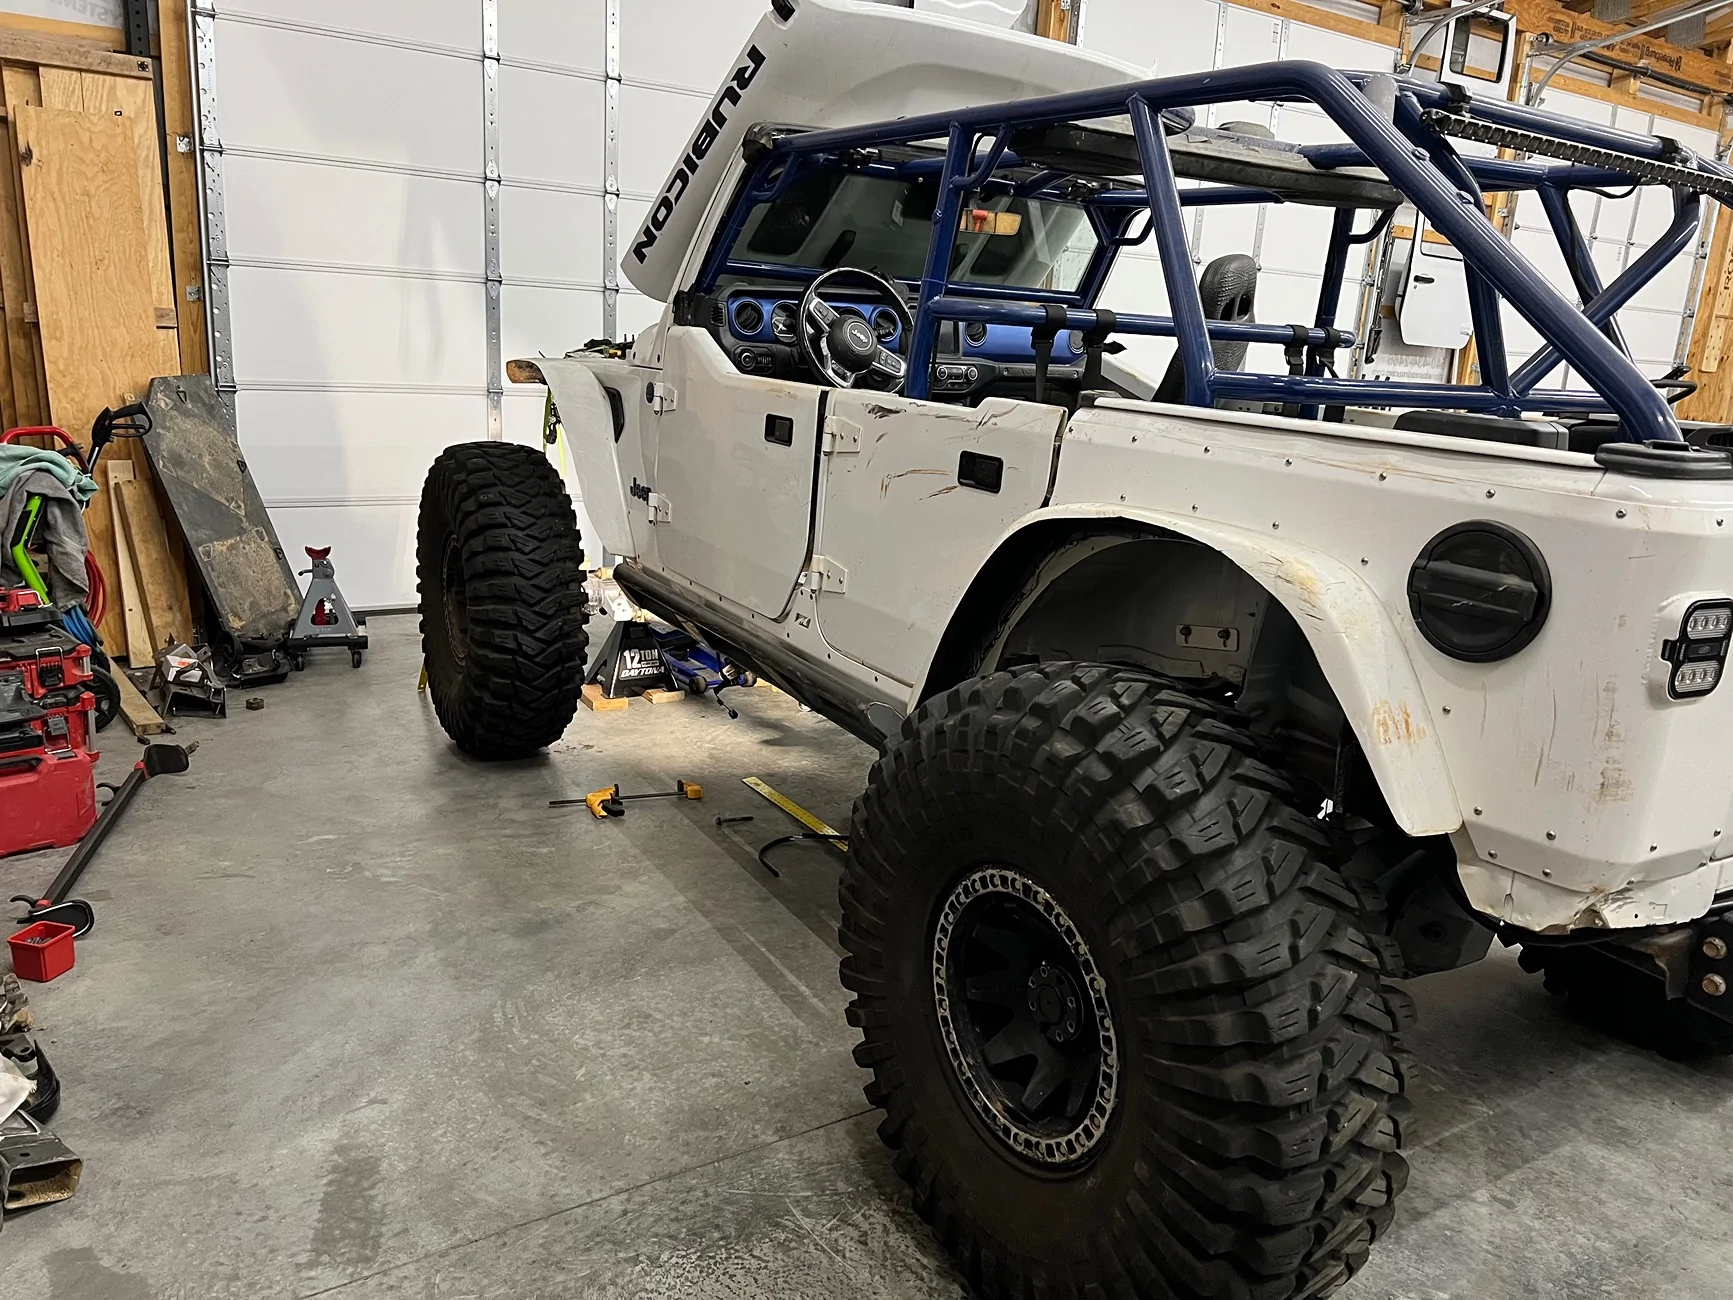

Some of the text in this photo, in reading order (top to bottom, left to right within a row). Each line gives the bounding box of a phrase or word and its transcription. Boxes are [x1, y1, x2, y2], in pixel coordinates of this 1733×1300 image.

[632, 43, 767, 265] RUBICON
[851, 329, 868, 343] Jeep
[623, 648, 659, 670] 12 TON
[620, 665, 665, 678] DAYTONA
